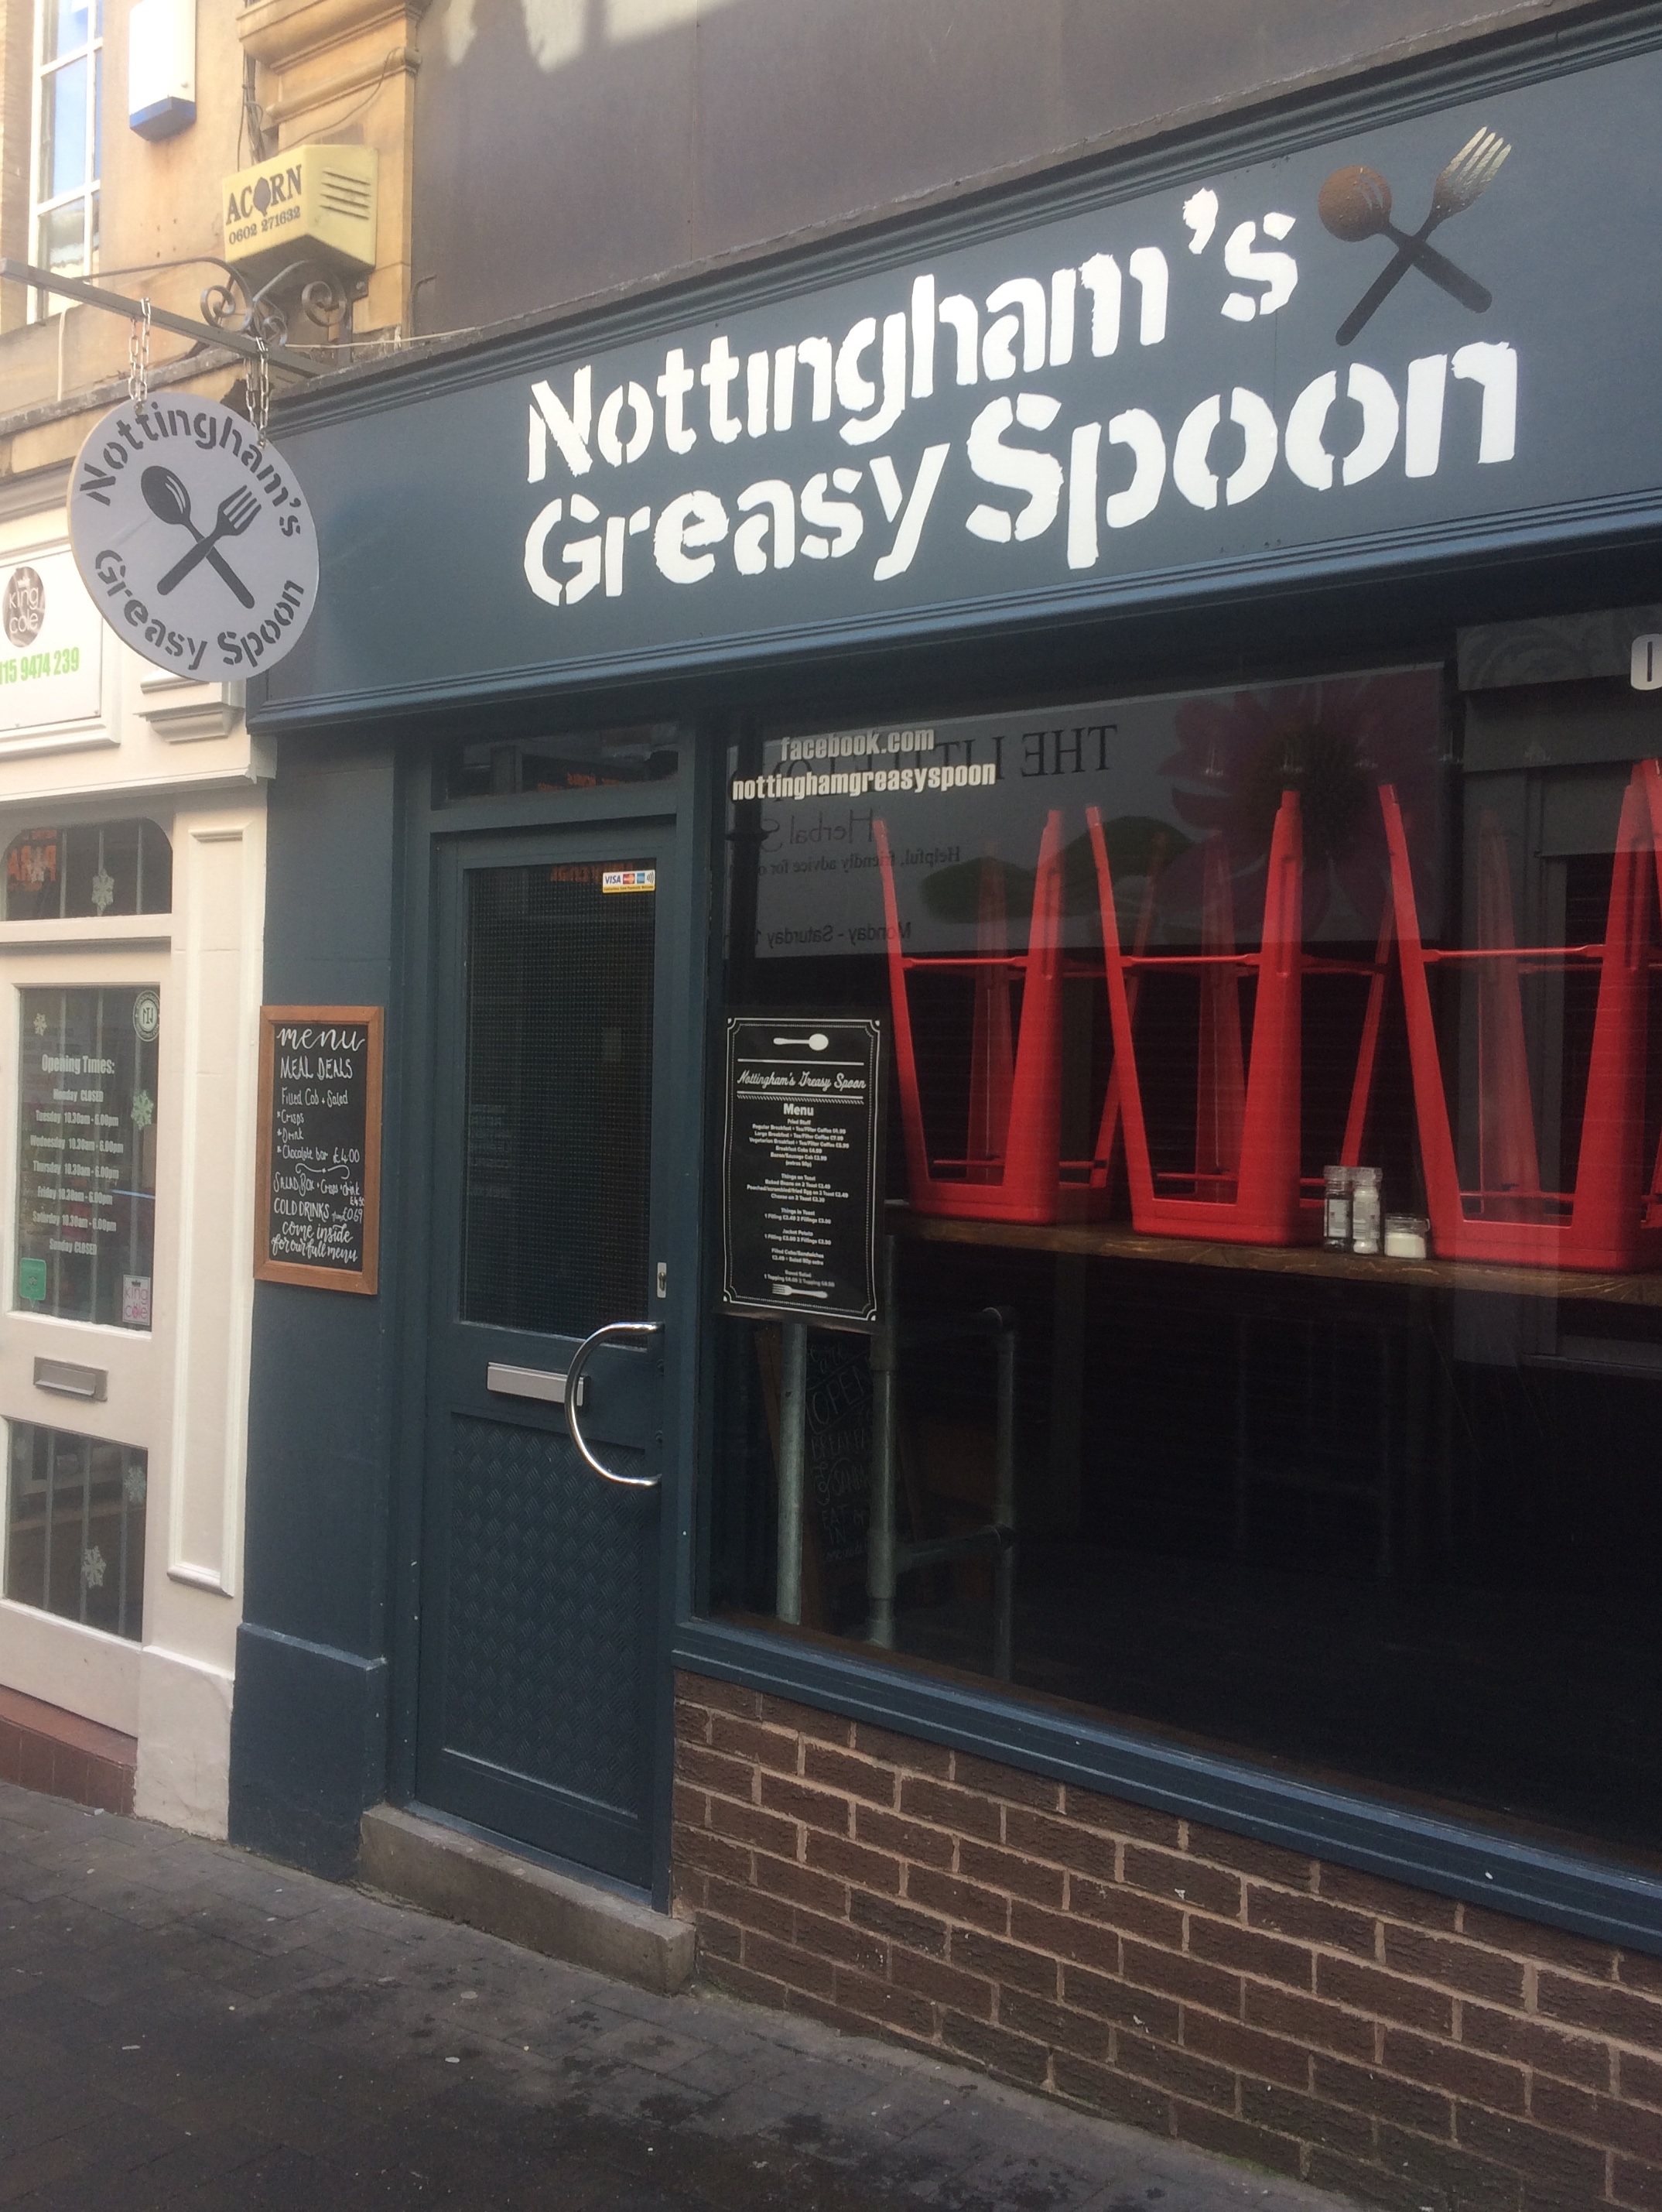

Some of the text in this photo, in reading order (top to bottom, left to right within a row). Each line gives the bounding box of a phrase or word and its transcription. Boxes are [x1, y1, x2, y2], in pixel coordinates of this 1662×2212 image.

[228, 205, 301, 245] 0602 271632
[527, 187, 1299, 484] Nottingham's
[80, 402, 302, 537] Nottingham's
[524, 341, 1518, 607] Greasy Spoon
[95, 550, 305, 670] Greasy Spoon
[20, 652, 50, 682] 9474
[53, 646, 80, 676] 239
[780, 728, 935, 762] facebook.com
[732, 762, 997, 800] nottinghamgreasyspoon
[605, 875, 621, 885] VISA
[276, 1027, 366, 1052] menu
[41, 1053, 115, 1075] Opening Times:
[280, 1055, 354, 1081] MEAL DEALS
[80, 1089, 104, 1102] CLOSED
[305, 1087, 320, 1106] Cob
[327, 1089, 349, 1108] Salad
[783, 1103, 815, 1116] Menu
[273, 1197, 298, 1216] COLD
[299, 1200, 330, 1223] DRINKS
[282, 1221, 354, 1244] come inside
[271, 1233, 291, 1256] for
[327, 1245, 359, 1265] menu
